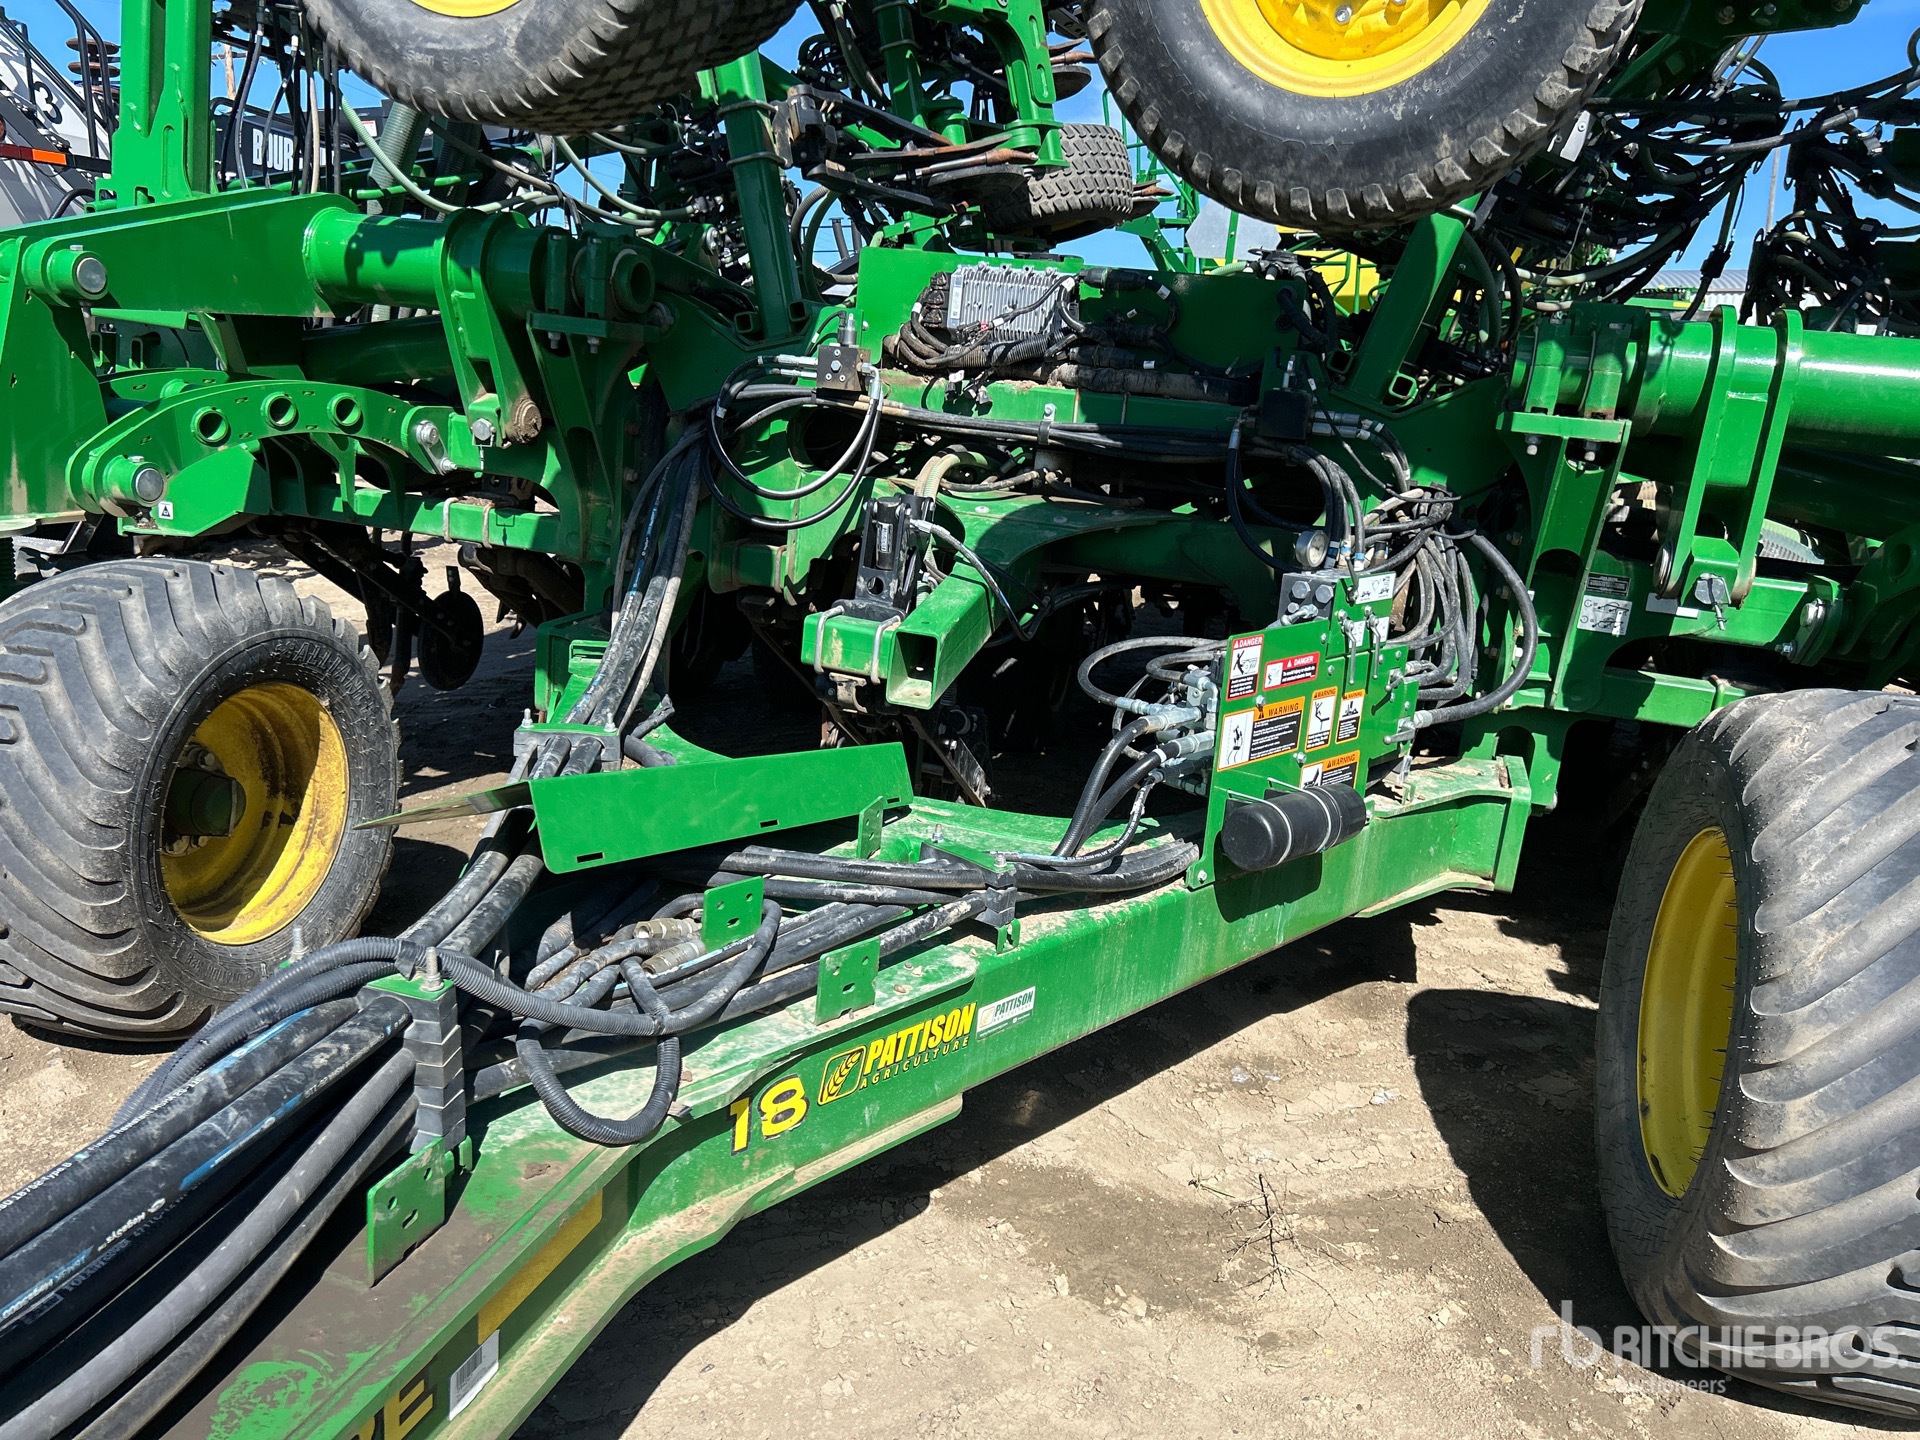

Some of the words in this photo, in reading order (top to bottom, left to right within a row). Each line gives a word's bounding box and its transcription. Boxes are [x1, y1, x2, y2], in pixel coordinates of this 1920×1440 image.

[1239, 636, 1263, 648] DANGER
[1316, 688, 1336, 699] WARNING
[1268, 702, 1299, 717] WARNING
[1331, 753, 1356, 769] WARNING
[994, 990, 1034, 1018] PATTISON
[864, 1002, 977, 1074] PATTISON
[860, 1036, 970, 1090] AGRICULTURE
[730, 1074, 810, 1157] 18
